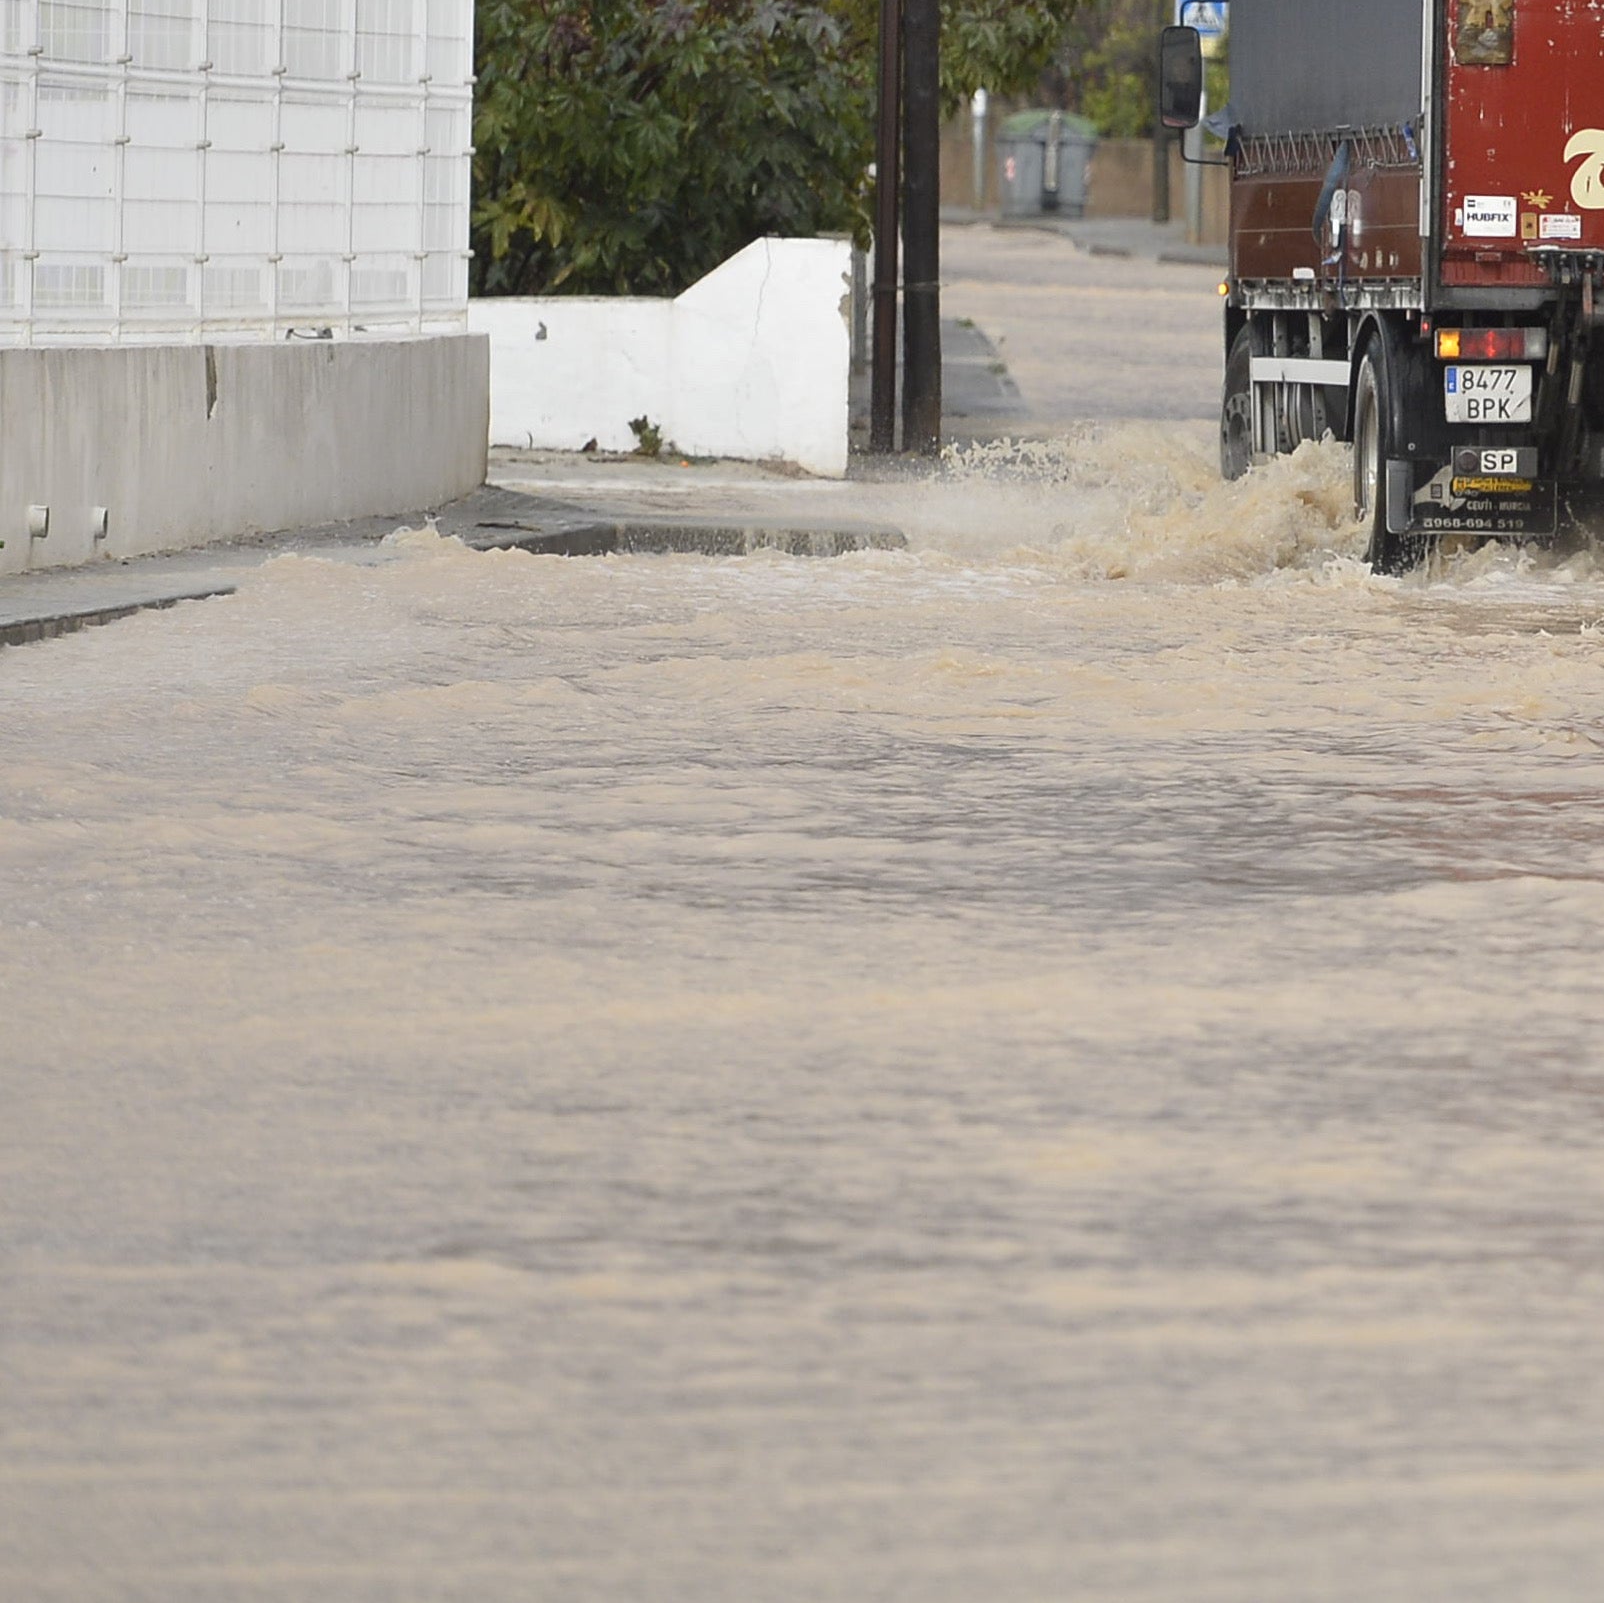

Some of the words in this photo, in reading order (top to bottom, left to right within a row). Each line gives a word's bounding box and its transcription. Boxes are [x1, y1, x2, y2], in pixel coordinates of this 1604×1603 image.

[1462, 369, 1517, 390] 8477
[1467, 398, 1511, 419] BPK
[1483, 453, 1514, 471] SP
[1434, 517, 1493, 529] 968-694
[1497, 518, 1525, 529] 519
